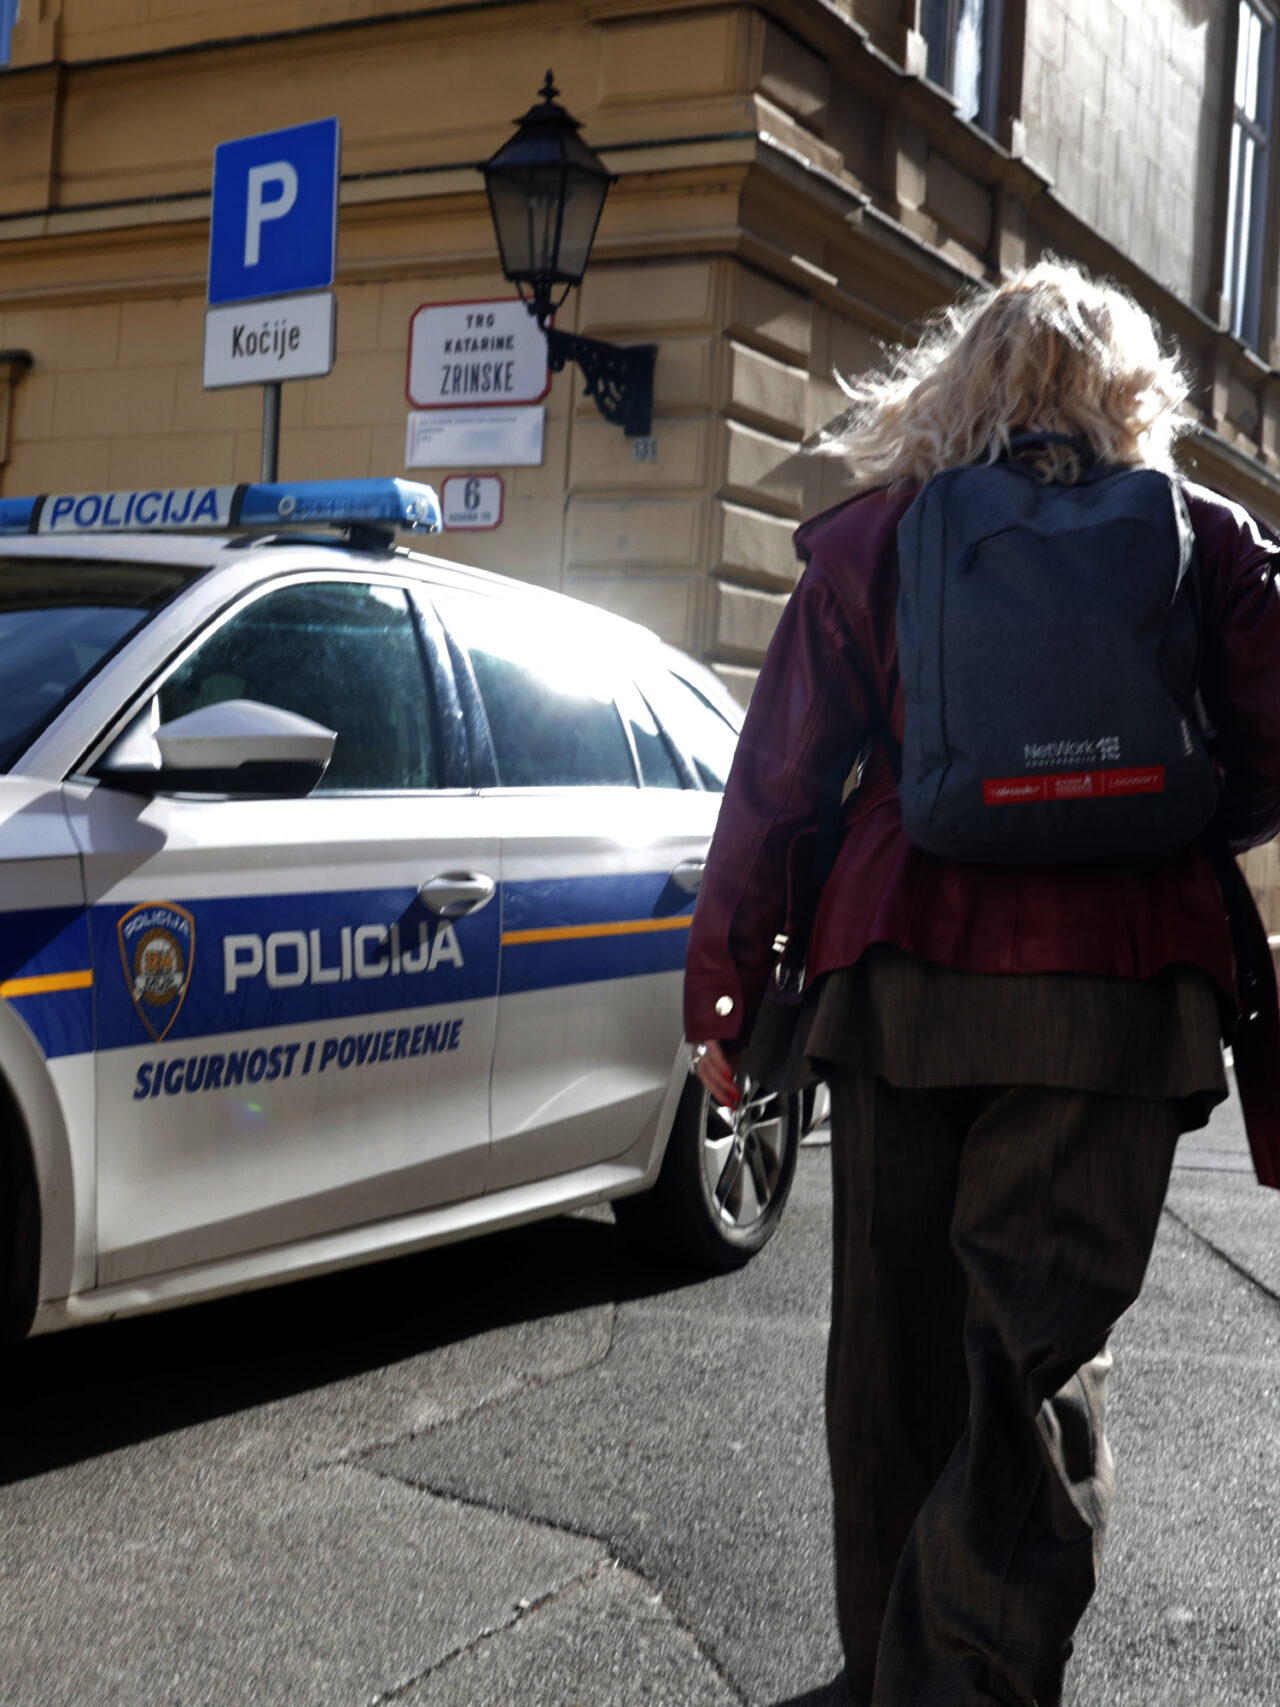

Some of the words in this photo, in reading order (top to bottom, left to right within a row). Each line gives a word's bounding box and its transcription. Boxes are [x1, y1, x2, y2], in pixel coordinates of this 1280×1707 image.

[243, 160, 298, 268] P
[231, 318, 300, 361] Kočije
[466, 313, 495, 329] TRG
[443, 334, 515, 354] KATARINE
[440, 361, 516, 396] ZRINSKE
[49, 488, 219, 529] POLICIJA
[464, 478, 481, 510] 6
[124, 910, 189, 939] POLICIJA
[223, 921, 464, 995] POLICIJA
[132, 1041, 301, 1101] SIGURNOST
[303, 1041, 315, 1075] I
[319, 1018, 464, 1074] POVJERENJE
